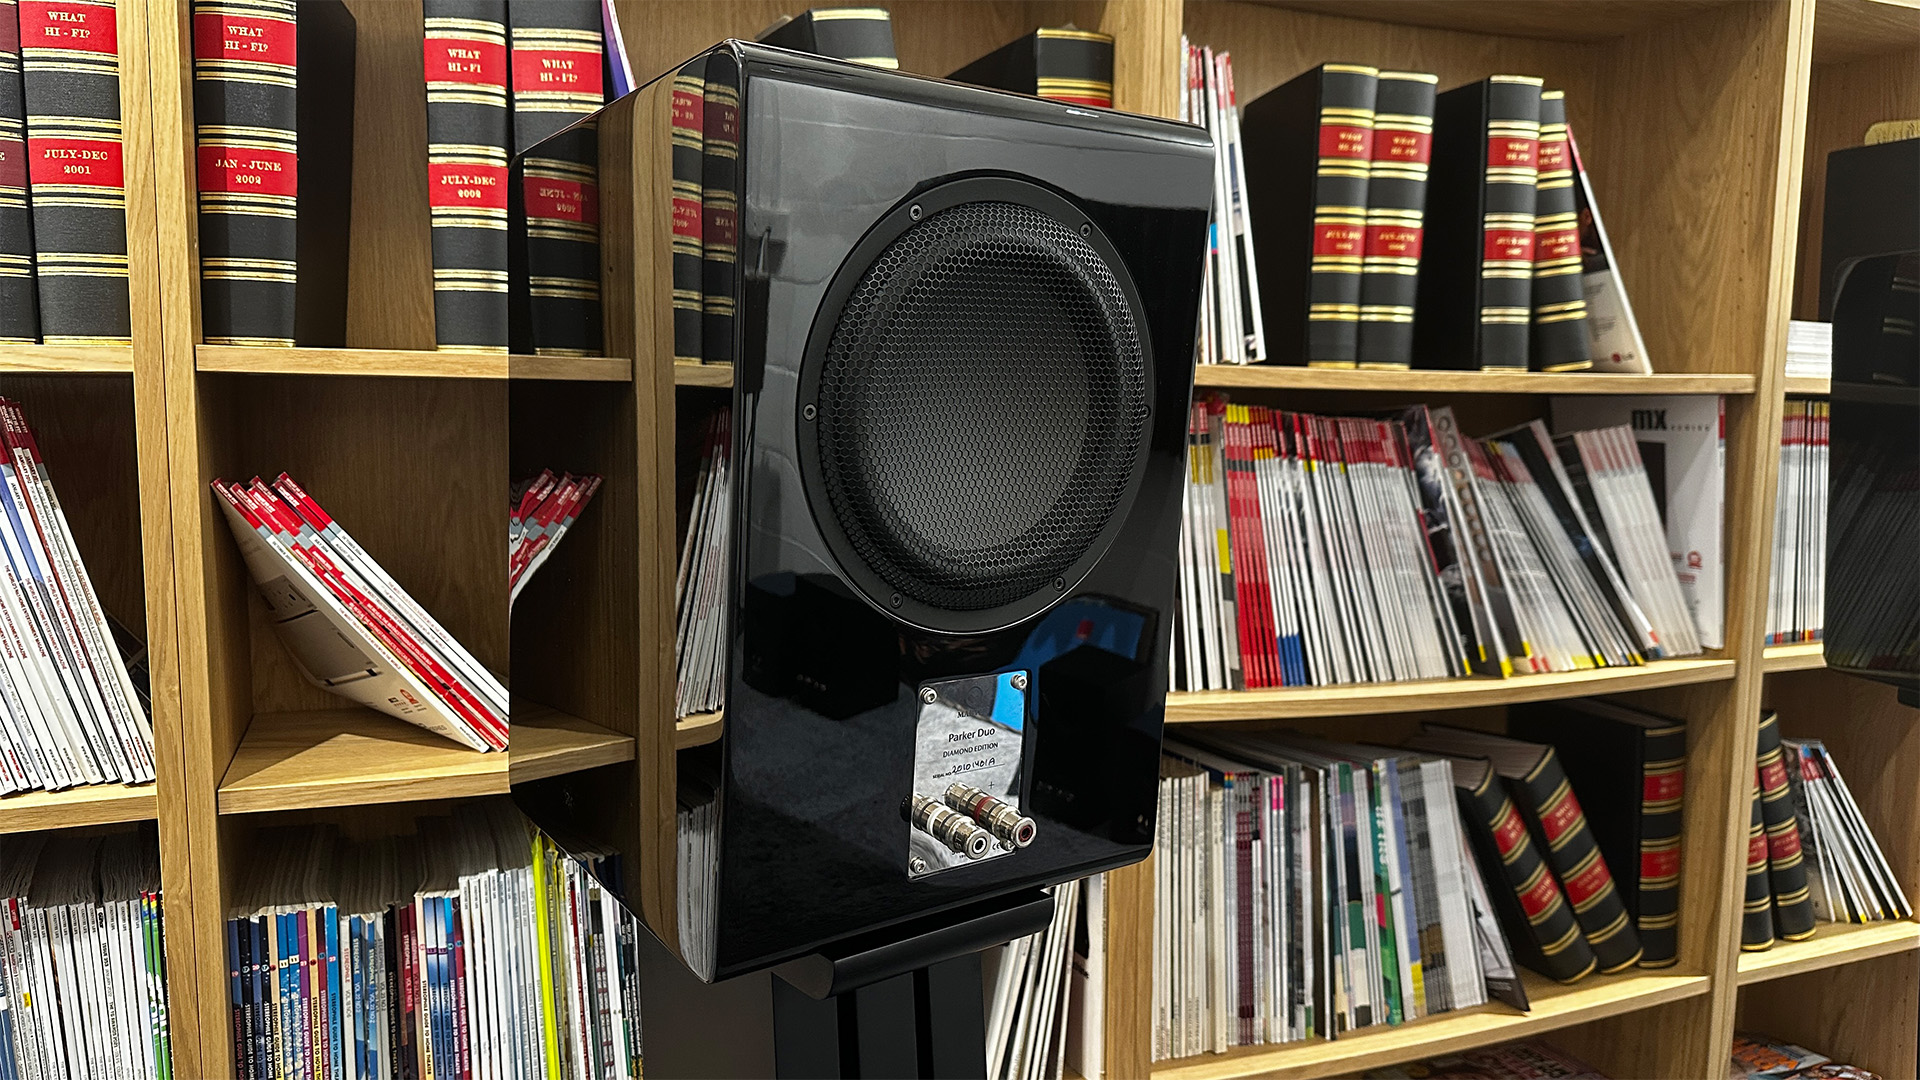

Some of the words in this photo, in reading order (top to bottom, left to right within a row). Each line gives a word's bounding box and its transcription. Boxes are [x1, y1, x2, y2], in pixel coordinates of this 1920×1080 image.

[47, 11, 86, 23] WHAT
[44, 27, 60, 36] HI
[71, 28, 91, 38] FI?
[227, 25, 264, 37] WHAT
[224, 40, 240, 50] HI
[250, 42, 268, 52] FI?
[447, 49, 481, 60] WHAT
[448, 62, 461, 72] HI
[542, 59, 574, 70] WHAT
[540, 72, 553, 82] HI
[44, 149, 108, 160] JULY-DEC
[63, 165, 91, 175] 2001
[215, 159, 238, 168] JAN
[249, 160, 282, 172] JUNE
[235, 174, 262, 185] 2002
[441, 175, 496, 186] JULY-DEC
[457, 189, 481, 199] 2002
[10, 482, 20, 500] JANUARY
[948, 731, 976, 742] Parker
[977, 728, 995, 737] Duo
[942, 747, 973, 758] DIAMOND
[974, 742, 998, 752] EDITION
